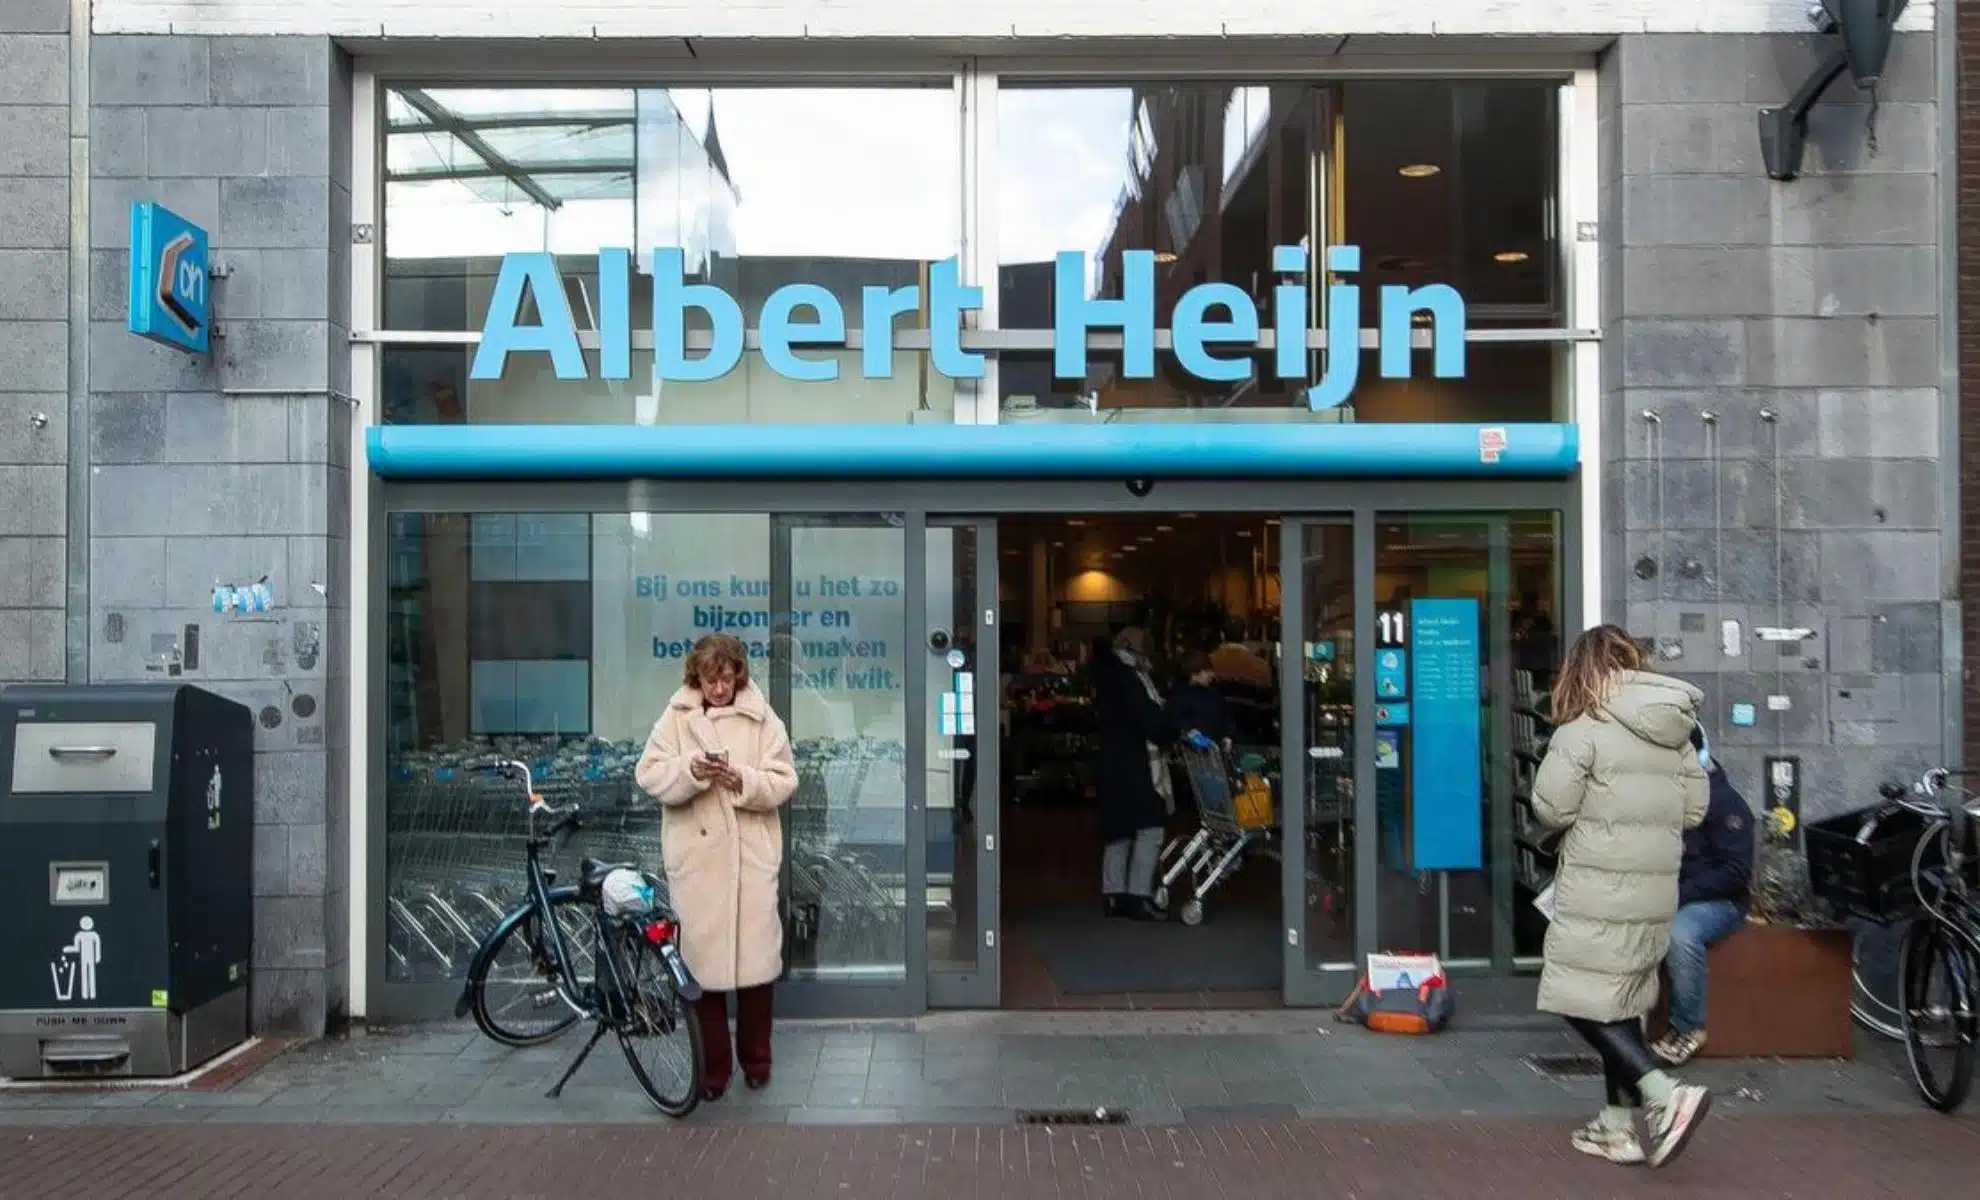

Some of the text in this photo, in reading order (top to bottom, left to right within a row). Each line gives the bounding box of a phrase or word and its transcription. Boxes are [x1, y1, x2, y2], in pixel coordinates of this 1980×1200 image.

[469, 244, 1467, 412] Albert Heijn
[635, 574, 667, 602] Bij
[677, 579, 721, 597] ons
[796, 580, 811, 597] u
[820, 574, 861, 597] het
[869, 579, 898, 597] zo
[693, 604, 850, 632] bijzoner en
[1379, 612, 1404, 644] 11
[801, 635, 888, 657] maken
[845, 666, 900, 690] wilt.
